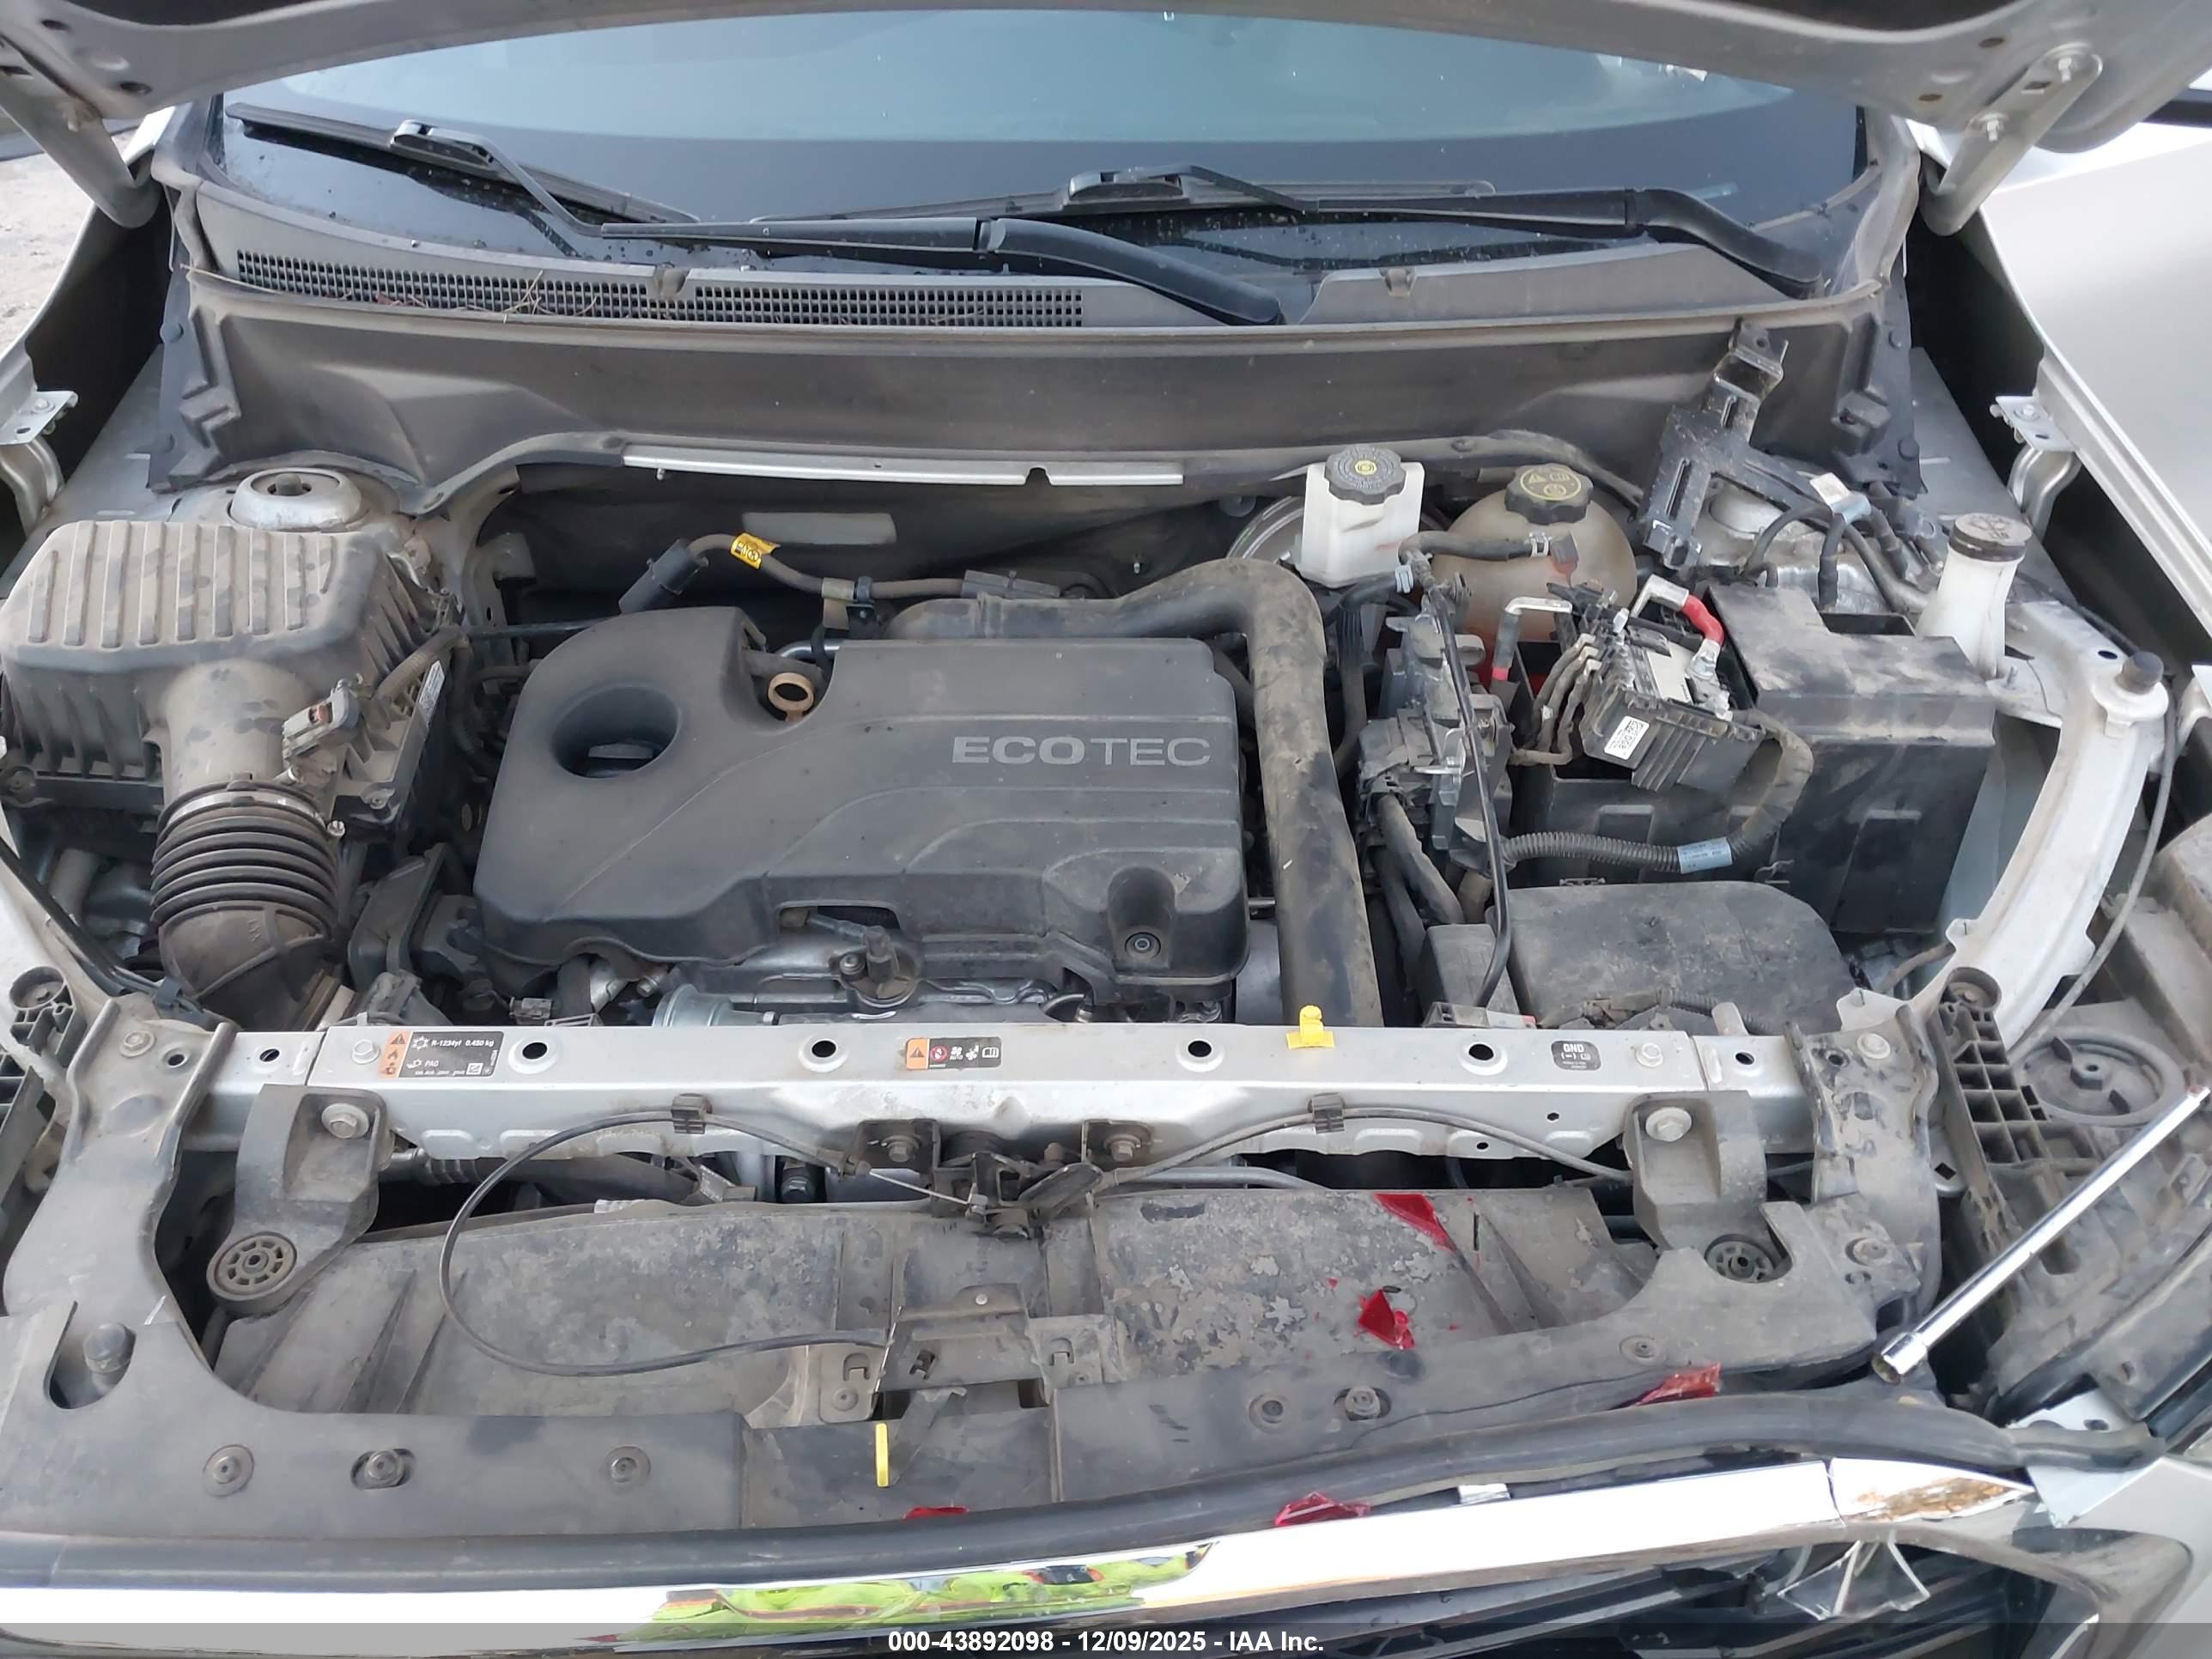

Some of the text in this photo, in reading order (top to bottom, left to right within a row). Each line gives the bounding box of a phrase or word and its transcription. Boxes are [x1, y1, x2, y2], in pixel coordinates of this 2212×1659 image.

[951, 734, 1211, 766] ECOTEC
[431, 1039, 462, 1048] R-1234yf
[484, 1039, 495, 1048] kg
[1563, 1043, 1584, 1053] GND
